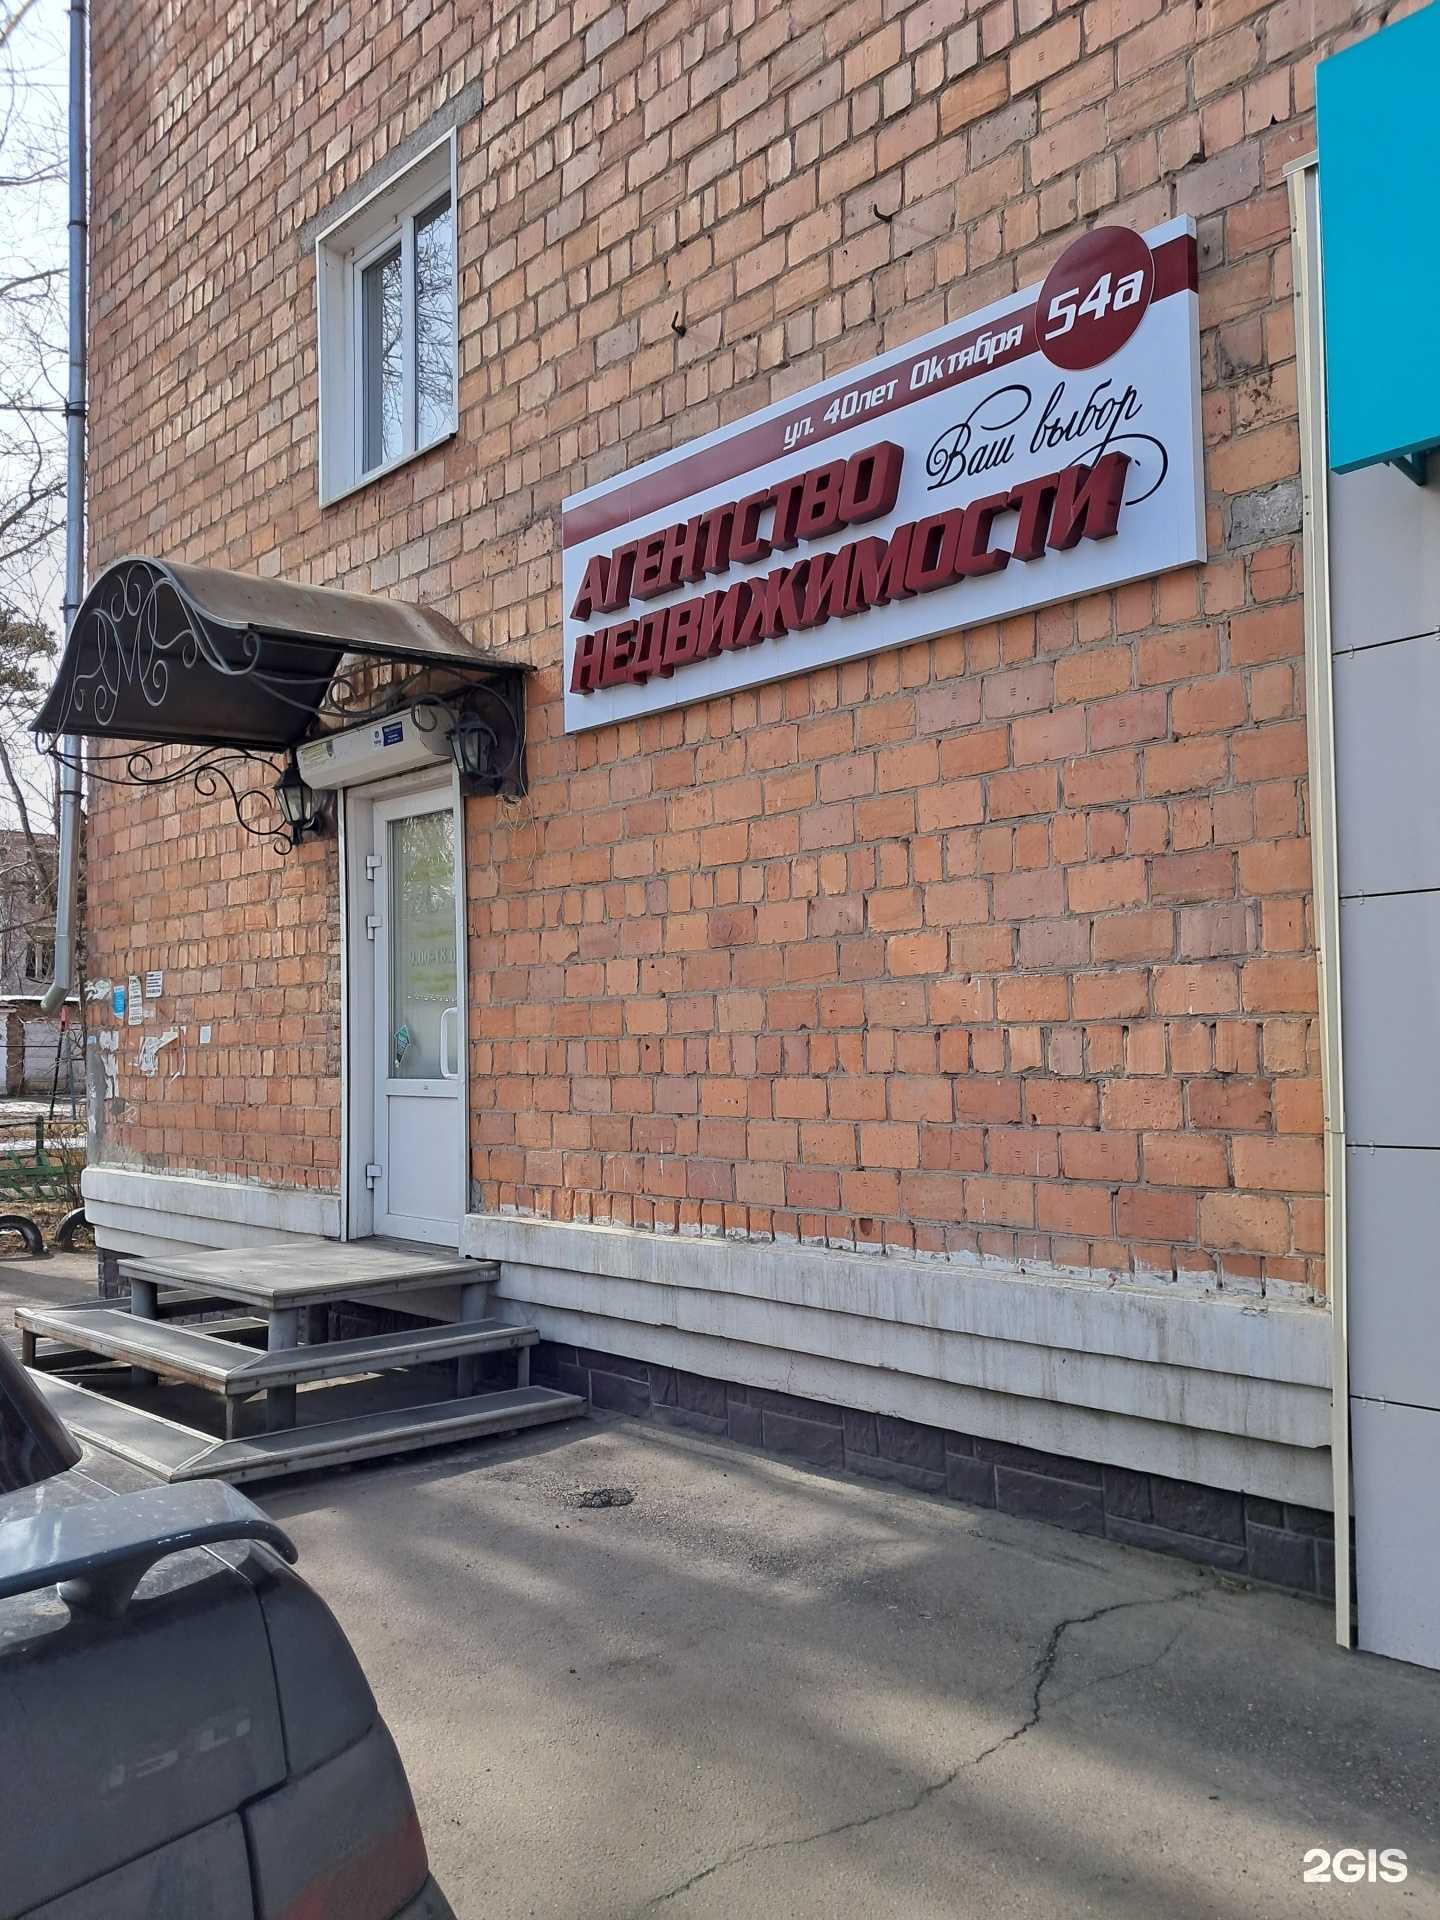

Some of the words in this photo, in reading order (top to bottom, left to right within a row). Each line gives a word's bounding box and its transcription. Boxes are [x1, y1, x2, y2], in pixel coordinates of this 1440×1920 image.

[783, 419, 814, 451] ул.
[909, 323, 1024, 390] Октября
[1045, 269, 1144, 341] 54а
[926, 384, 1032, 491] Ваш
[1029, 378, 1168, 506] выбор
[568, 451, 1131, 695] НЕДВИЖИМОСТИ
[569, 440, 904, 622] АГЕНТСТВО
